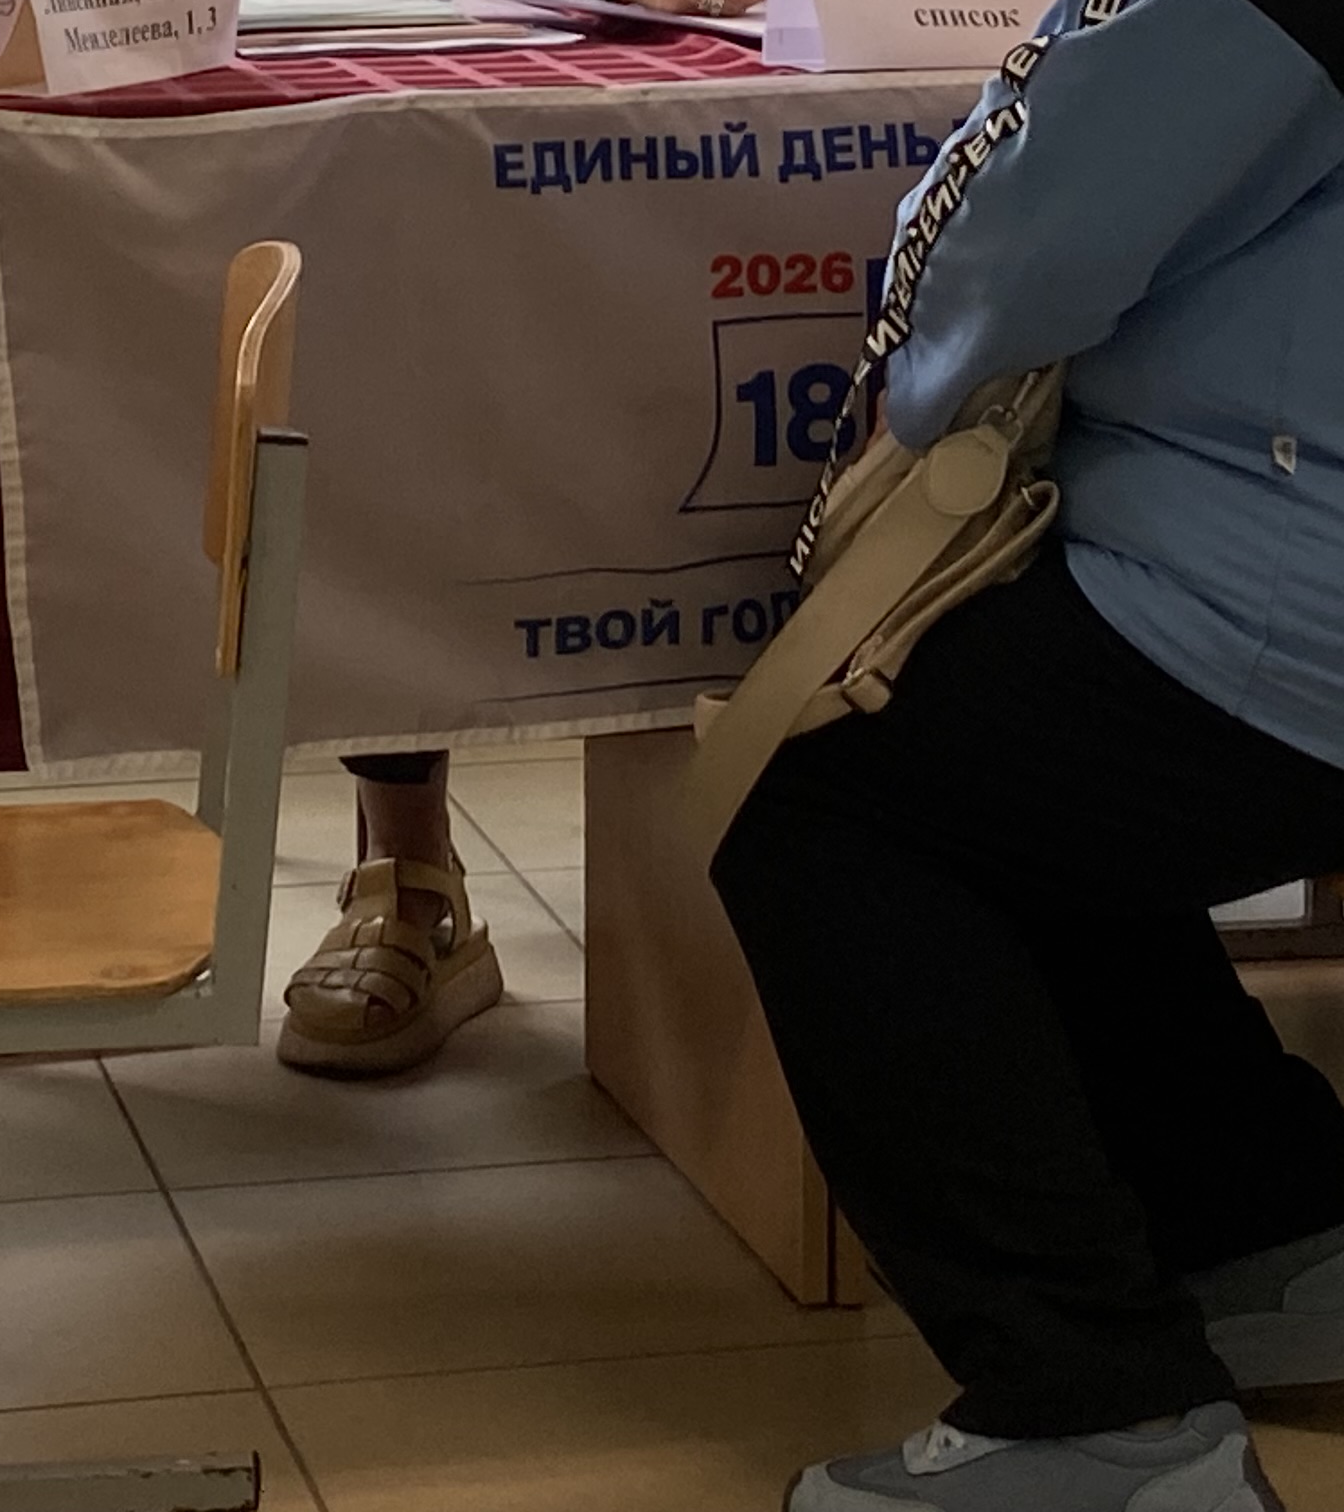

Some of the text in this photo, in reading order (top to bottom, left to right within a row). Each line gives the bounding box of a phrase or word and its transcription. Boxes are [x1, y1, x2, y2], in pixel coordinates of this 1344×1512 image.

[64, 19, 179, 55] Менделеева,
[205, 6, 218, 31] 3
[913, 4, 1021, 30] список
[493, 122, 760, 194] ЕДИНЫЙ
[778, 122, 941, 183] ДЕНЬ
[710, 251, 854, 299] 2026
[736, 363, 856, 467] 18
[515, 599, 680, 658] ТВОЙ
